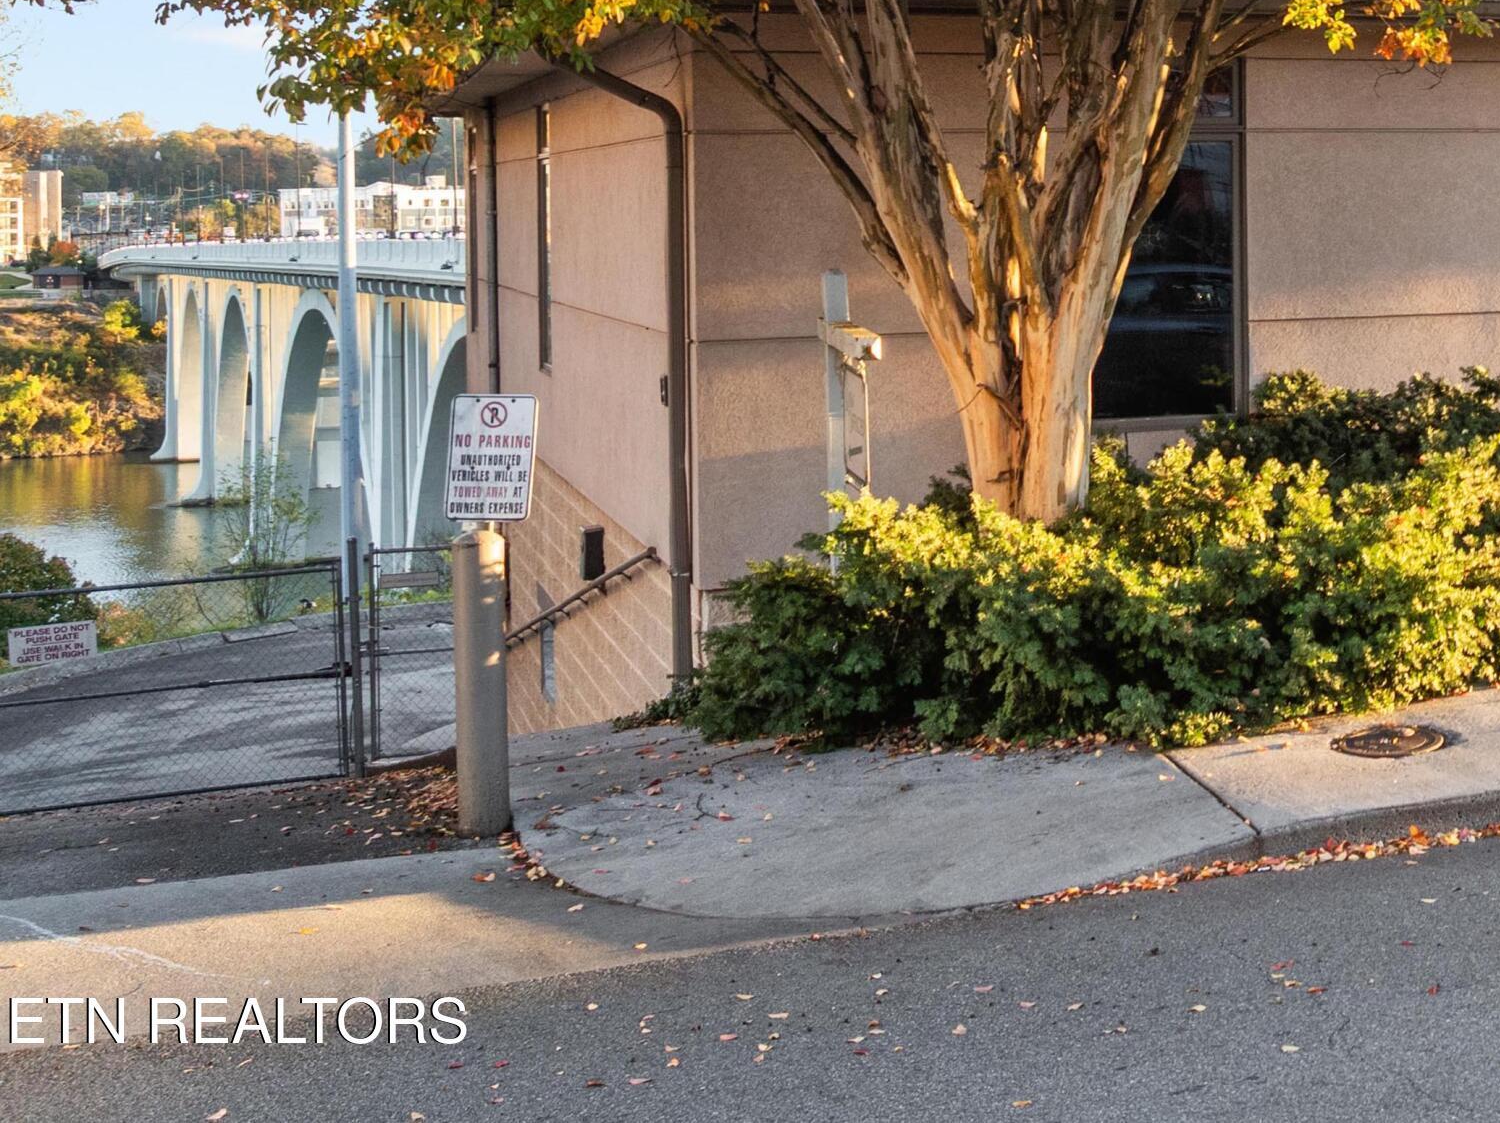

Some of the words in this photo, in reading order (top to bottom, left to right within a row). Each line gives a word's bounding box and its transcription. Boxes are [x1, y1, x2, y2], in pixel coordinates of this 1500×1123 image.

[455, 434, 472, 448] NO
[478, 434, 531, 448] PARKING
[460, 454, 521, 466] UNAUTHORIZED
[452, 470, 490, 482] VEHICLES
[494, 470, 513, 482] WILL
[518, 471, 527, 482] BE
[453, 486, 482, 498] TOWED
[486, 486, 507, 498] AWAY
[513, 487, 523, 498] AT
[449, 502, 484, 514] OWNERS
[488, 502, 524, 514] EXPENSE
[14, 628, 51, 638] PLEASE
[54, 625, 68, 634] DO
[70, 623, 90, 632] NOT
[25, 635, 52, 644] PUSH
[54, 632, 79, 641] GATE
[22, 646, 42, 655] USE
[44, 643, 72, 653] WALK
[17, 654, 42, 663] GATE
[44, 652, 59, 660] ON
[61, 649, 91, 658] RIGHT
